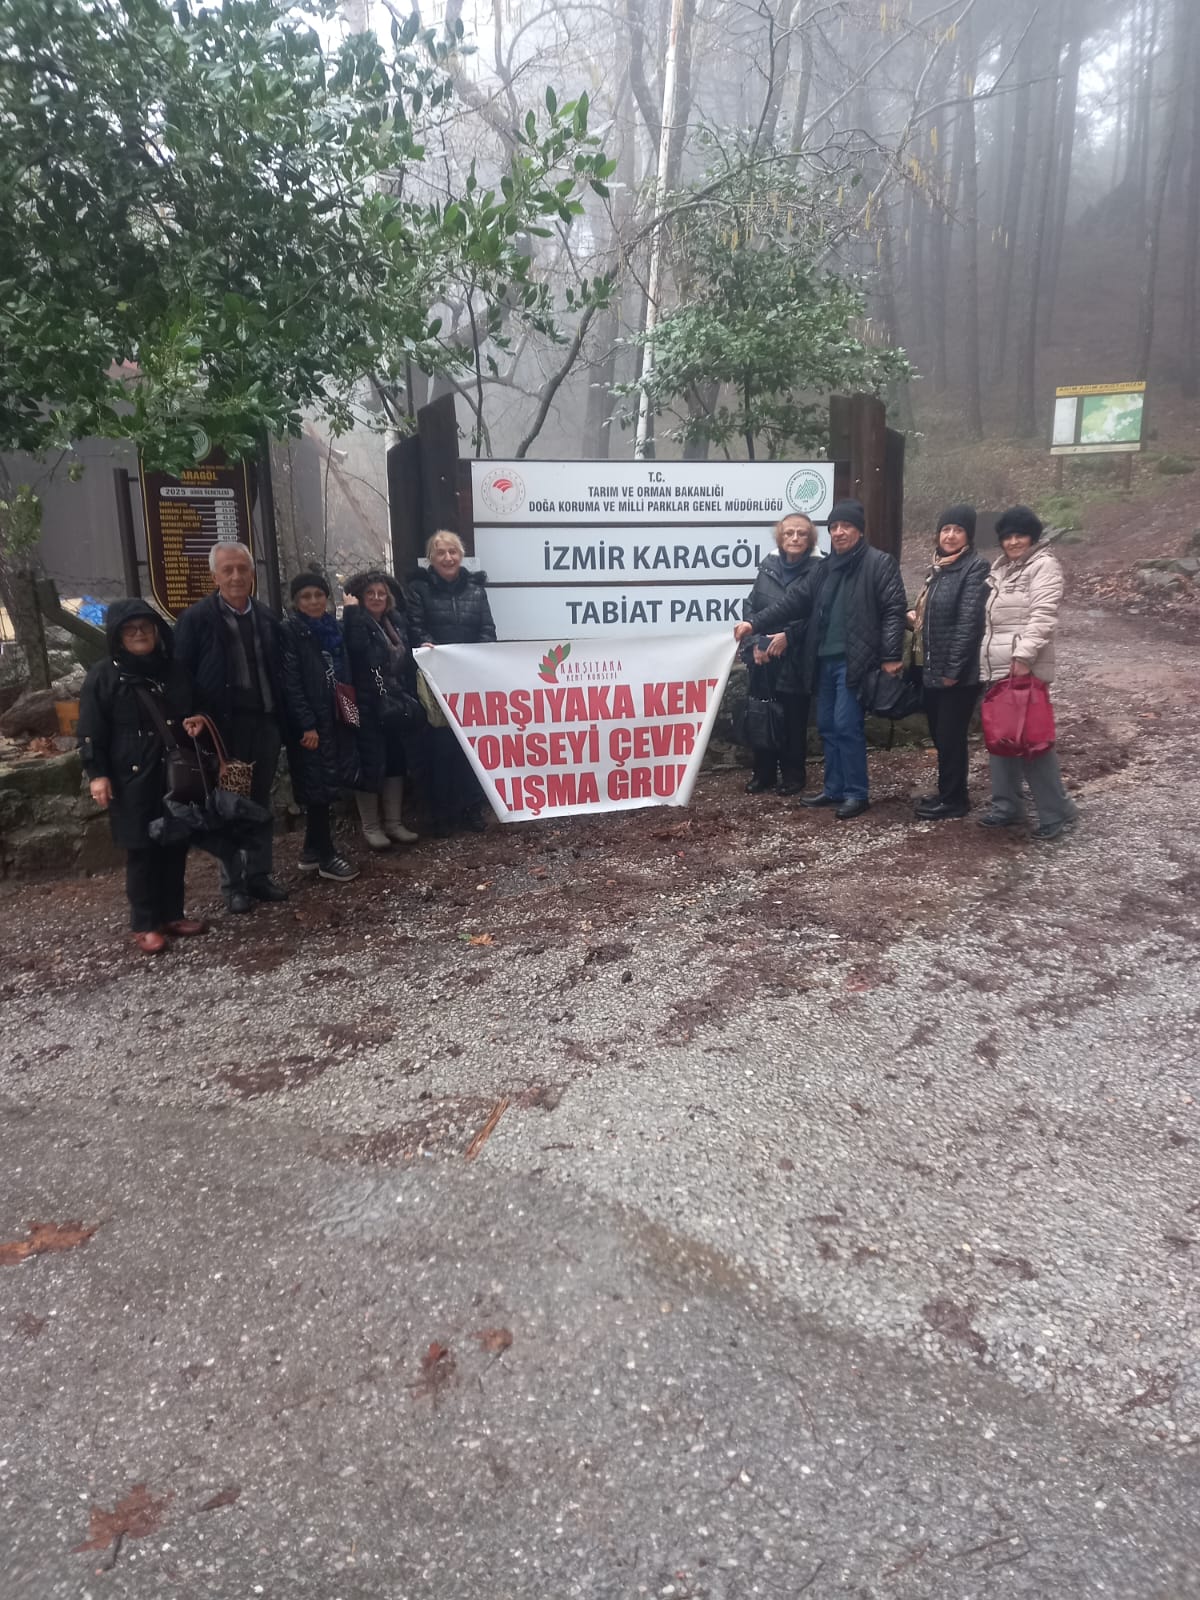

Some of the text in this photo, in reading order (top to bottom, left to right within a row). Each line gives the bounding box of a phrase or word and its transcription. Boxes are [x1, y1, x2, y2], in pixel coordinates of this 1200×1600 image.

[181, 470, 217, 480] ARAGÖL
[648, 472, 665, 482] T.C.
[165, 488, 186, 496] 2025
[588, 484, 724, 497] TARIM VE ORMAN BAKANLIĞI
[529, 498, 783, 512] DOĞA KORUMA VE MİLLİ PARKLAR GENEL MÜDÜRLÜĞÜ
[544, 539, 761, 570] İZMİR KARAGÖL
[566, 595, 663, 624] TABİAT
[467, 722, 702, 770] ONSEYİ ÇEVR
